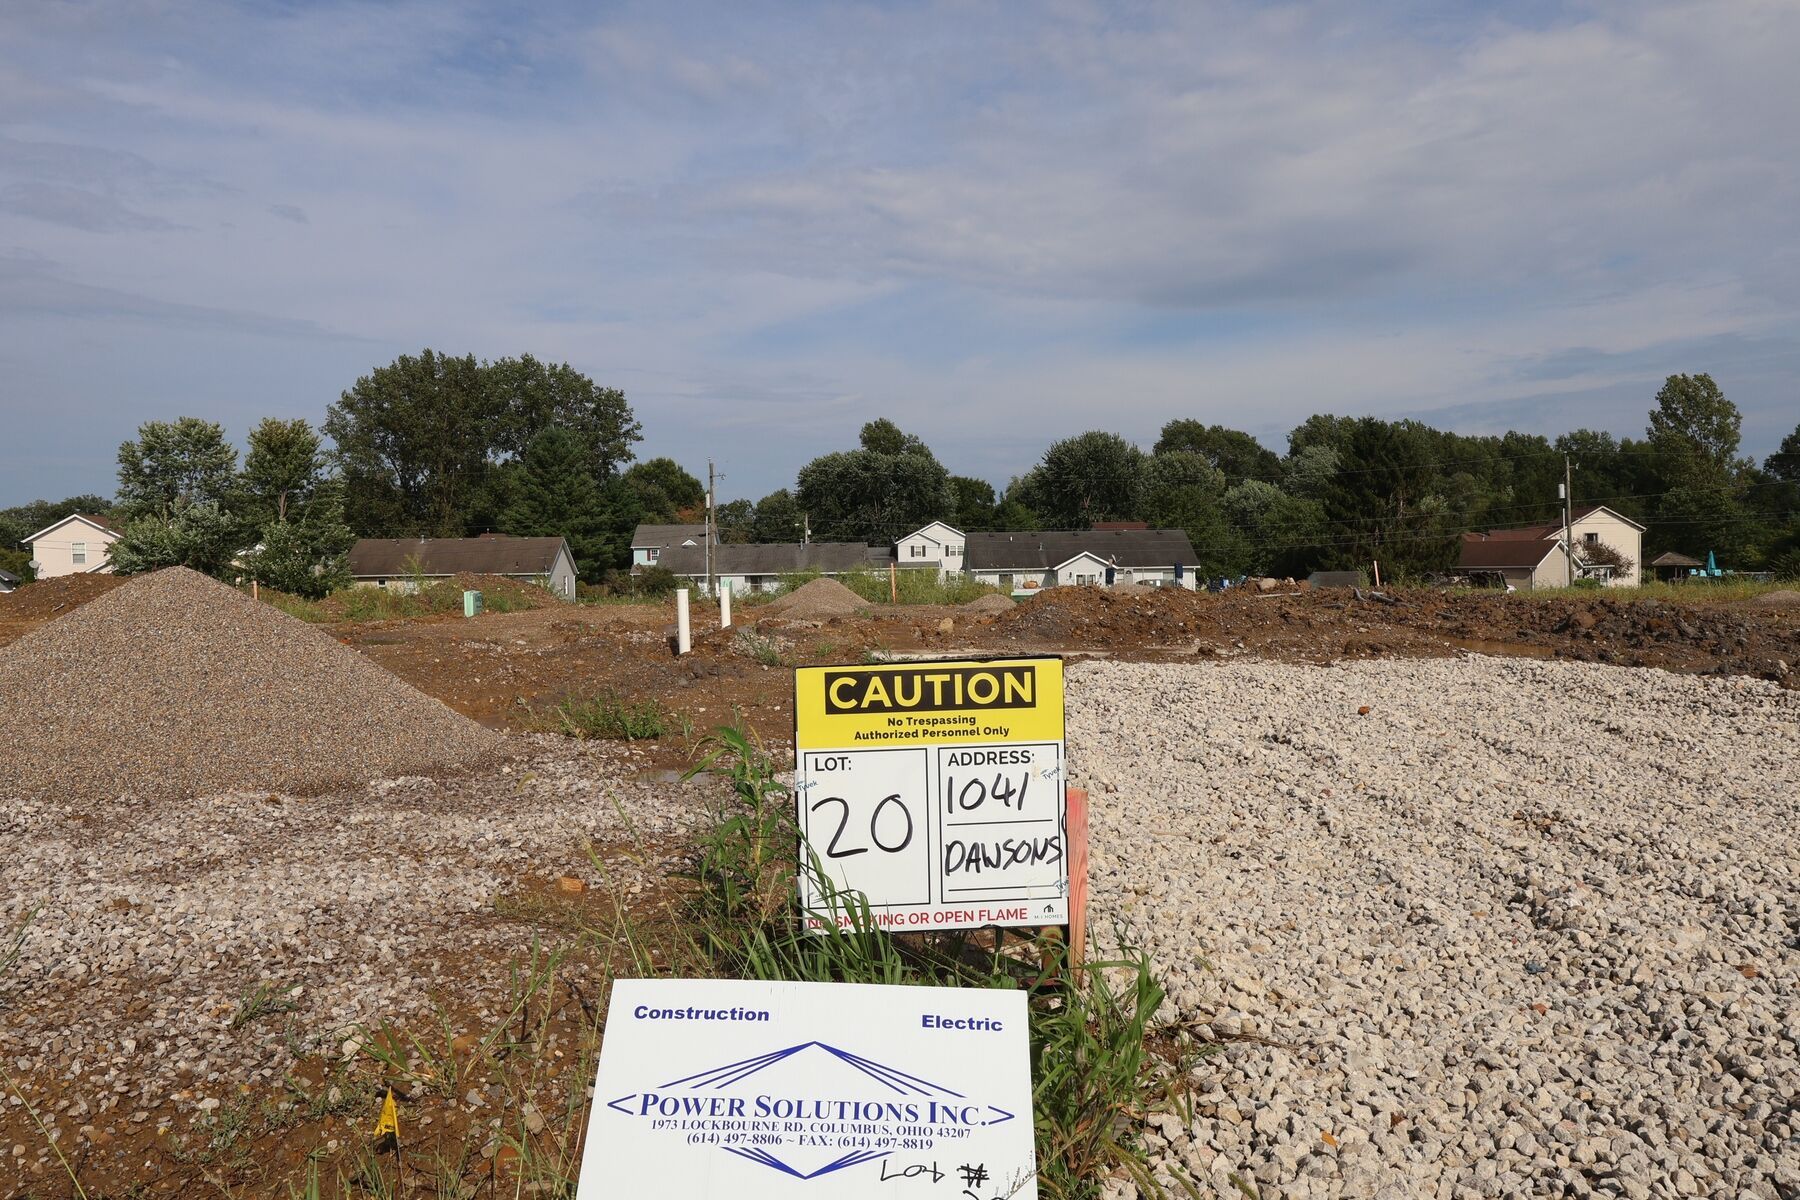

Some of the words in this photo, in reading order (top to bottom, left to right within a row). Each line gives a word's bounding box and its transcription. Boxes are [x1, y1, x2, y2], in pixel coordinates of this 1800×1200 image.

[828, 671, 1033, 709] CAUTION
[887, 717, 903, 727] No
[906, 715, 976, 728] Trespassing
[854, 729, 919, 741] Authorized
[922, 726, 981, 738] Personnel
[983, 726, 1010, 737] Only
[814, 756, 852, 772] LOT:
[947, 750, 1035, 767] ADDRESS:
[1042, 766, 1061, 780] Tyvek
[797, 780, 818, 791] Tyvek
[947, 771, 1029, 814] 1041
[811, 794, 913, 858] 20
[945, 836, 1063, 876] DAWSONS
[908, 912, 930, 925] OR
[933, 910, 975, 924] OPEN
[978, 908, 1028, 922] FLAME
[634, 1005, 770, 1021] Construction
[921, 1014, 1003, 1032] Electric
[640, 1093, 746, 1117] POWER
[754, 1094, 919, 1123] SOLUTIONS
[928, 1101, 986, 1126] INC.
[651, 1119, 678, 1131] 1973
[681, 1119, 780, 1133] LOCKBOURNE
[784, 1121, 806, 1133] RD.
[810, 1122, 893, 1137] COLUMBUS,
[896, 1125, 934, 1138] OHIO
[936, 1127, 971, 1139] 43207
[686, 1132, 720, 1146] (614)
[723, 1132, 783, 1145] 497-8806
[799, 1134, 833, 1147] FAX:
[837, 1136, 871, 1150] (614)
[874, 1136, 934, 1150] 497-8819
